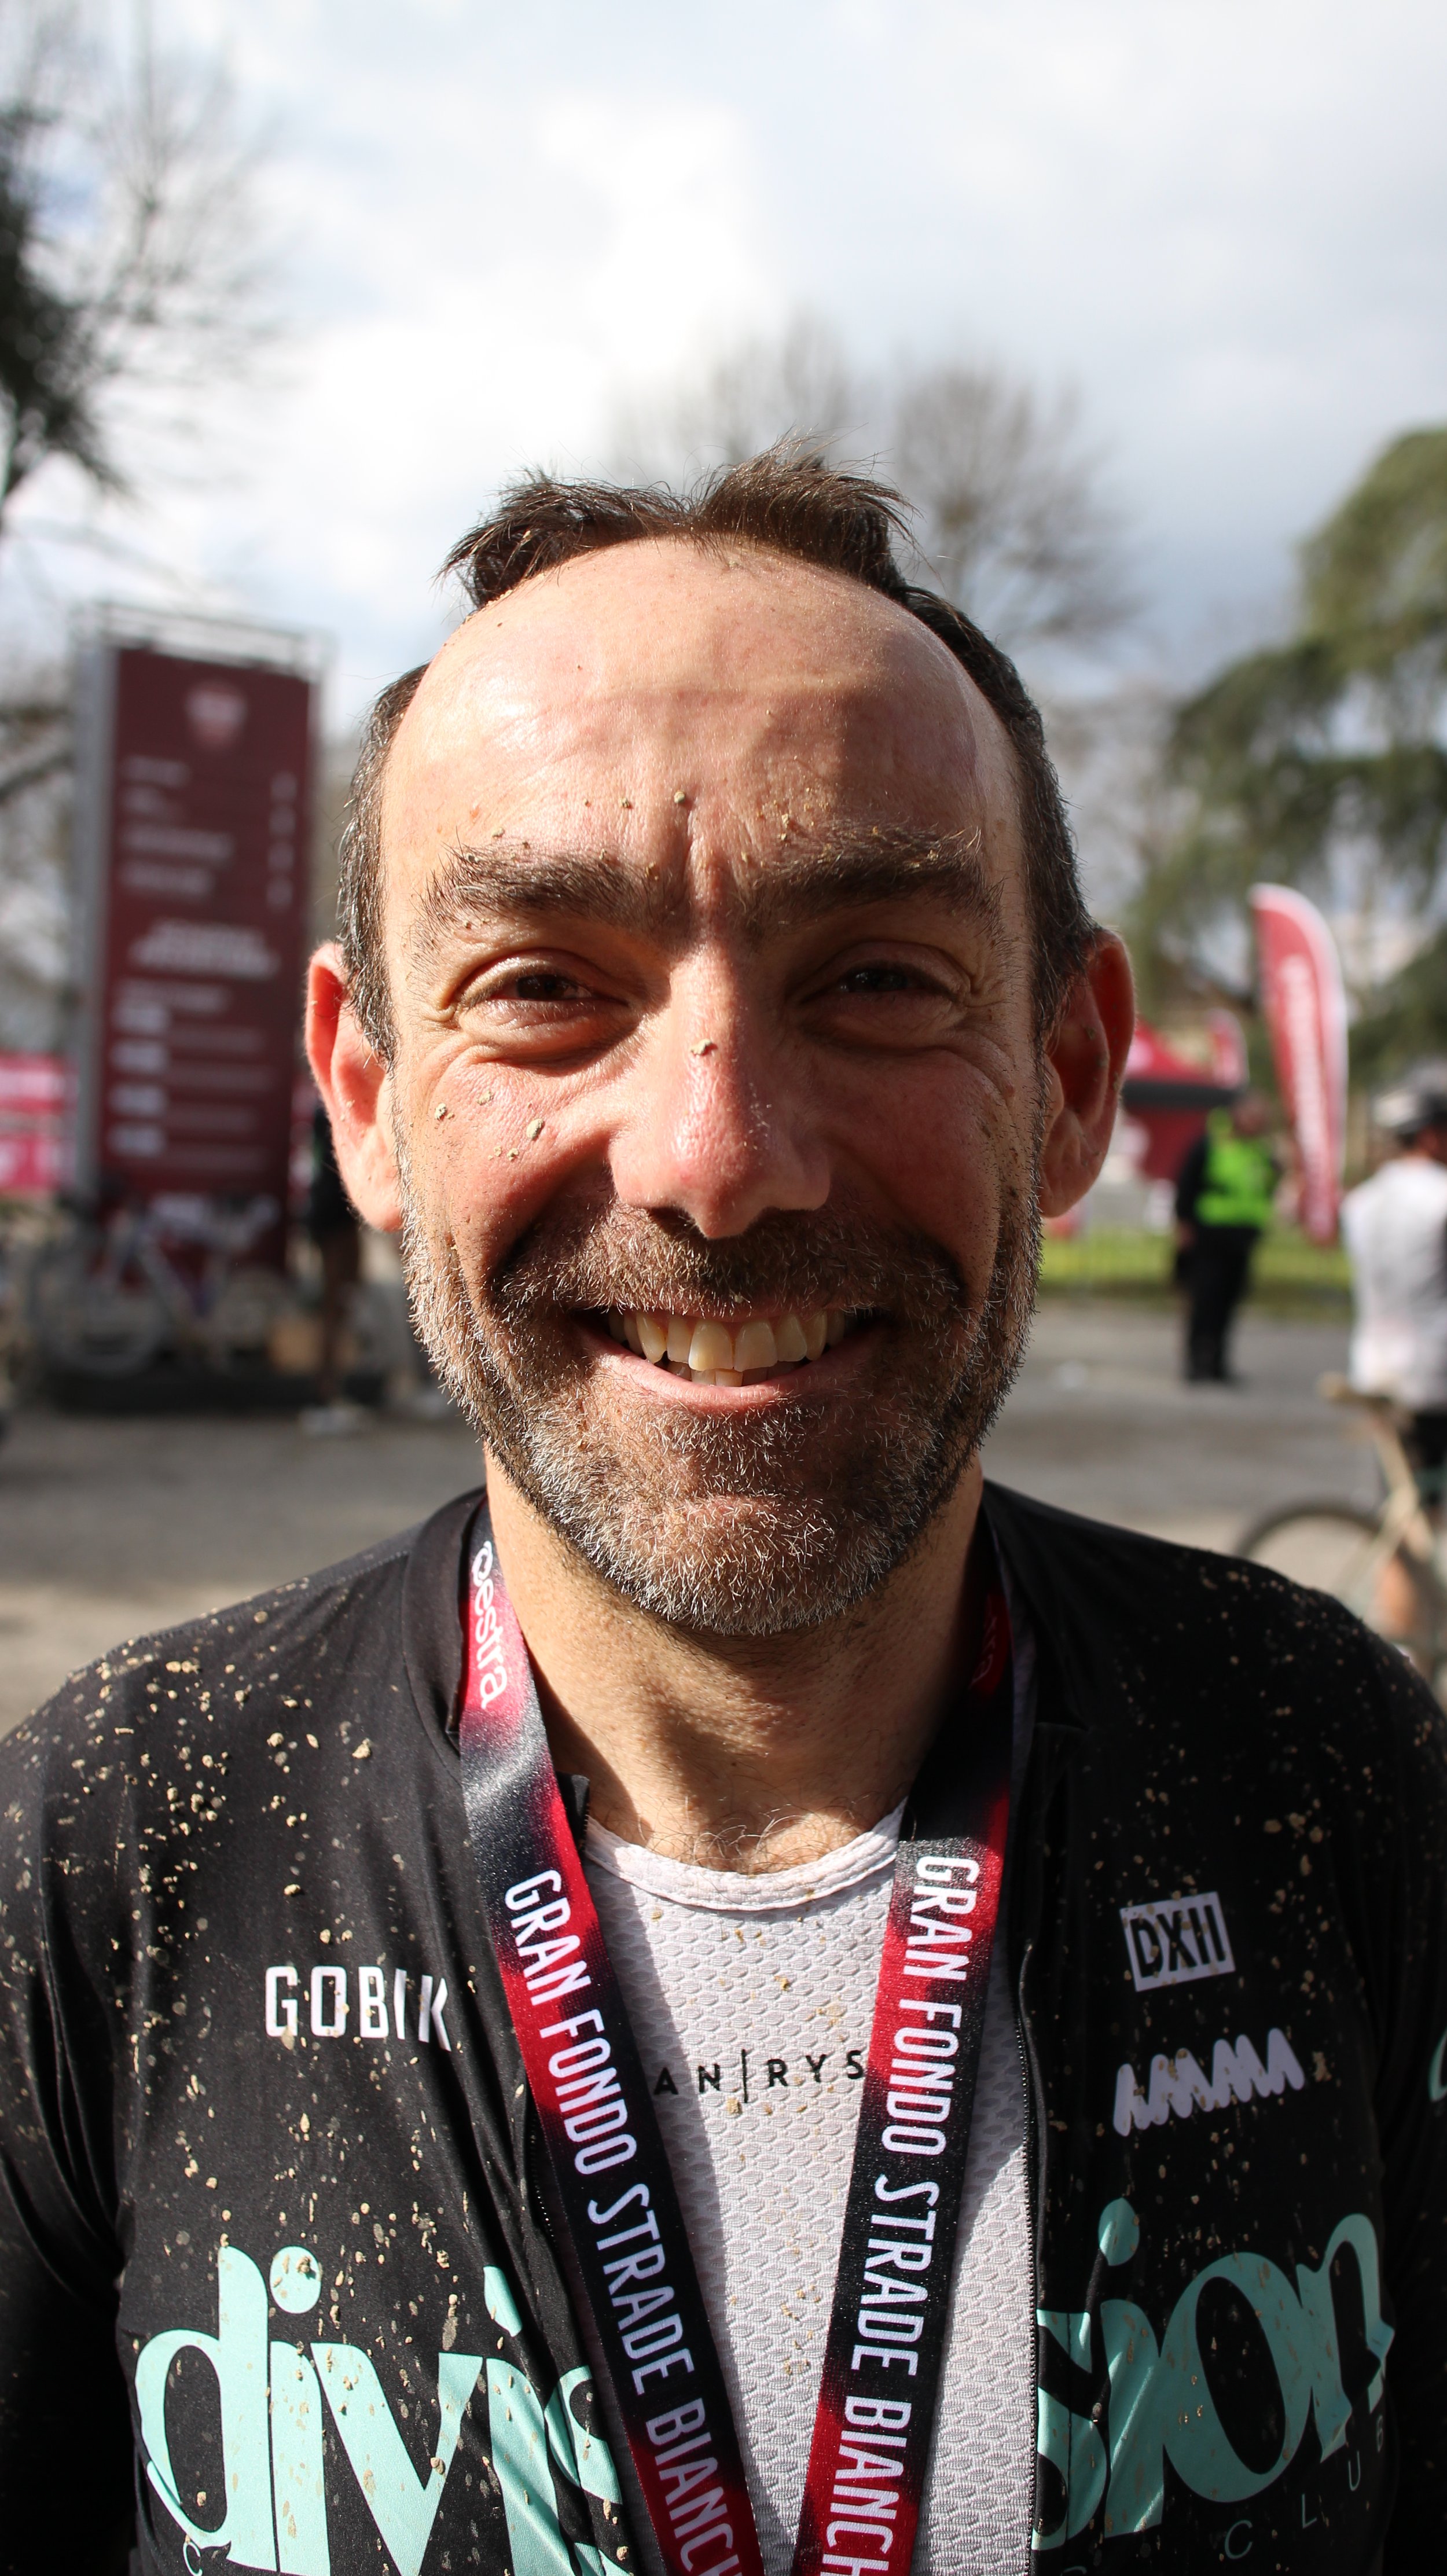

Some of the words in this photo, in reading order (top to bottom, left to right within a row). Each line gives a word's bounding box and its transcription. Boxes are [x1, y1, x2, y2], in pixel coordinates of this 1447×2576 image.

[504, 1869, 592, 2007] GRAN
[902, 1855, 979, 1981] GRAN
[1130, 1907, 1226, 1979] DXII
[265, 1965, 451, 2052] GOBIK
[882, 1998, 962, 2158] FONDO
[539, 2009, 637, 2176] FONDO
[587, 2184, 695, 2396] STRADE
[852, 2176, 941, 2377] STRADE
[1225, 2416, 1384, 2559] CLUB
